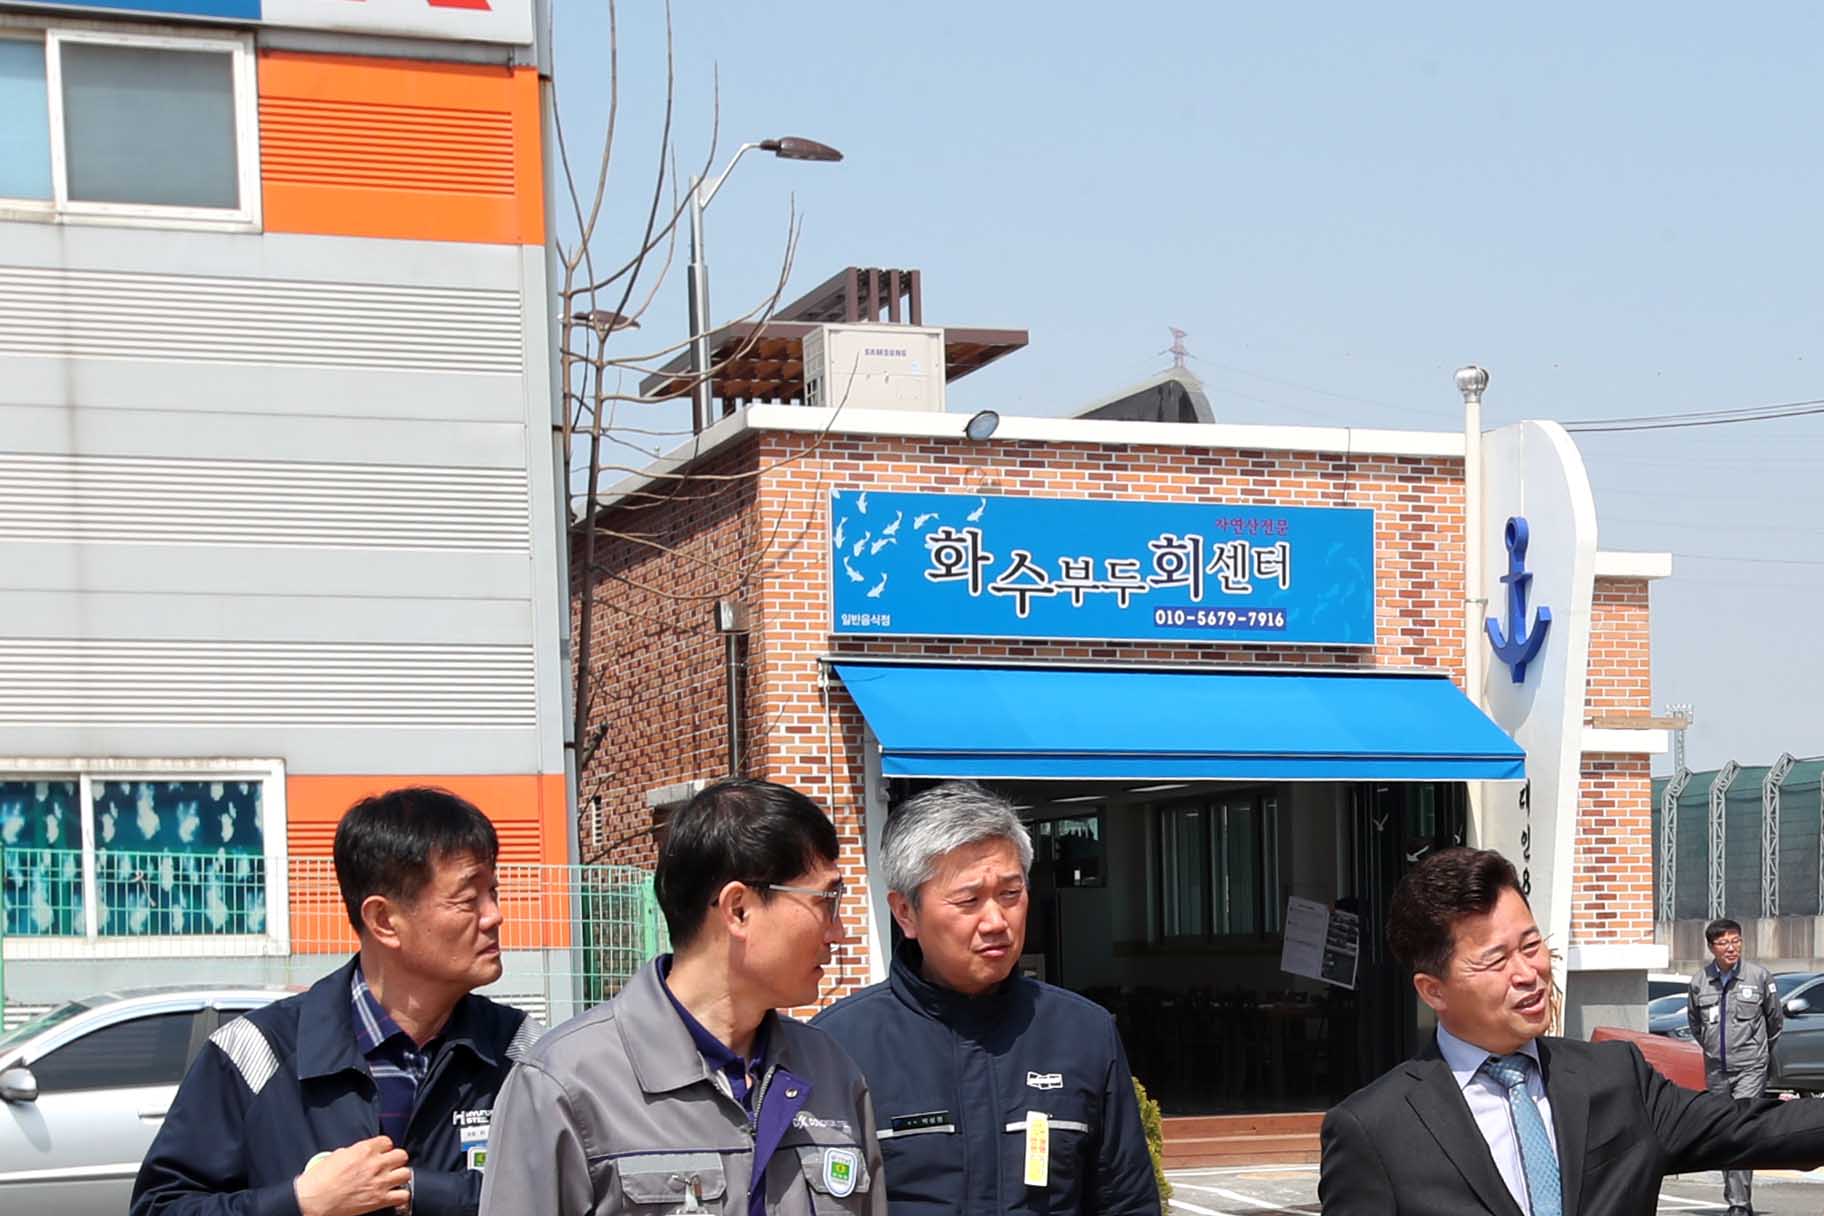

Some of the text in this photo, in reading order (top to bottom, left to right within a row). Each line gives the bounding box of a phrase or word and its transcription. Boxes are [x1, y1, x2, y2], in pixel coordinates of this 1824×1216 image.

[864, 348, 907, 357] SAMSUNG
[841, 613, 891, 627] 일반음식점
[1155, 608, 1285, 627] 010-5679-7916
